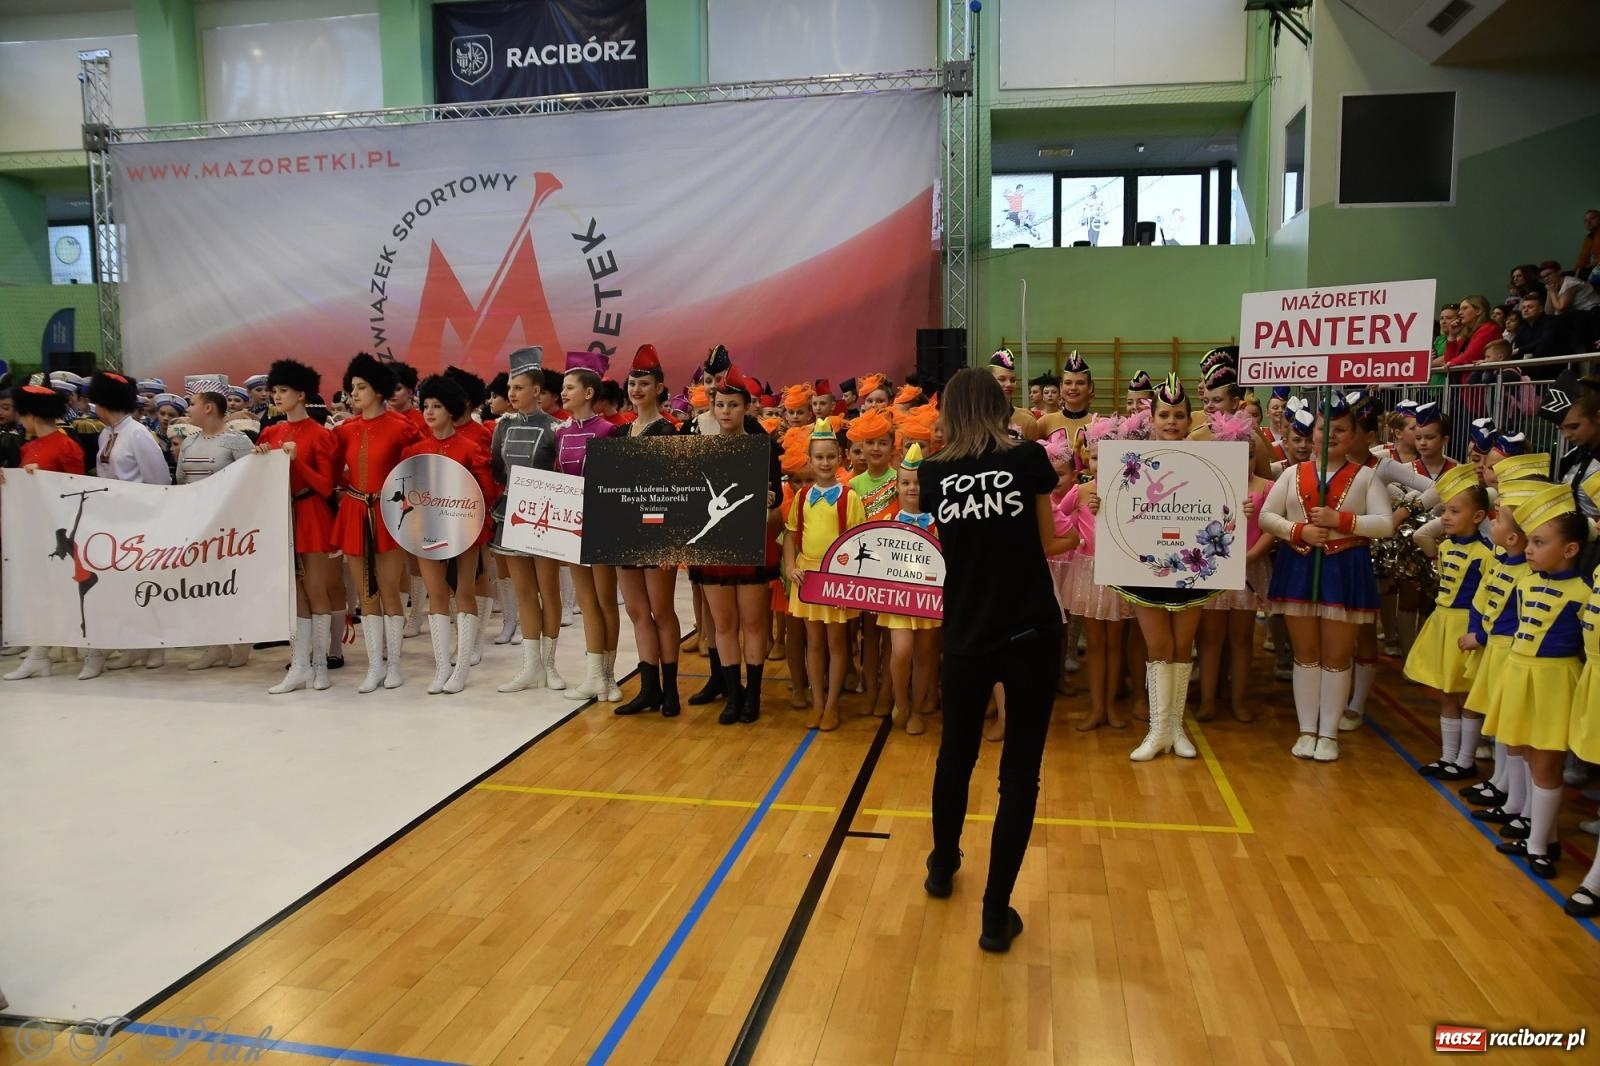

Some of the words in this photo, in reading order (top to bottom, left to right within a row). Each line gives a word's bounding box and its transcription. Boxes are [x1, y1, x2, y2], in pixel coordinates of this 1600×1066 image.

[506, 36, 637, 68] RACIBÓRZ
[126, 150, 401, 182] WWW.MAZORETKI.PL
[392, 173, 518, 242] SPORTOWY
[1281, 289, 1387, 311] MAŻORETKI
[1254, 312, 1418, 350] PANTERY
[1247, 361, 1319, 380] Gliwice
[1339, 356, 1415, 378] Poland
[597, 485, 631, 494] Taneczna
[633, 484, 669, 493] Akademia
[670, 484, 706, 494] Sportowa
[940, 470, 1014, 496] FOTO
[621, 494, 647, 504] Royals
[649, 493, 689, 503] Mażoretki
[938, 490, 1024, 524] GANS
[1131, 492, 1212, 514] Fanaberia
[518, 500, 583, 532] CHARMS
[876, 537, 924, 552] STRZELCE
[891, 551, 932, 565] WIELKIE
[886, 567, 923, 580] POLAND
[135, 568, 238, 608] Poland
[822, 580, 911, 608] MAŻORETKI
[916, 592, 944, 612] VIV
